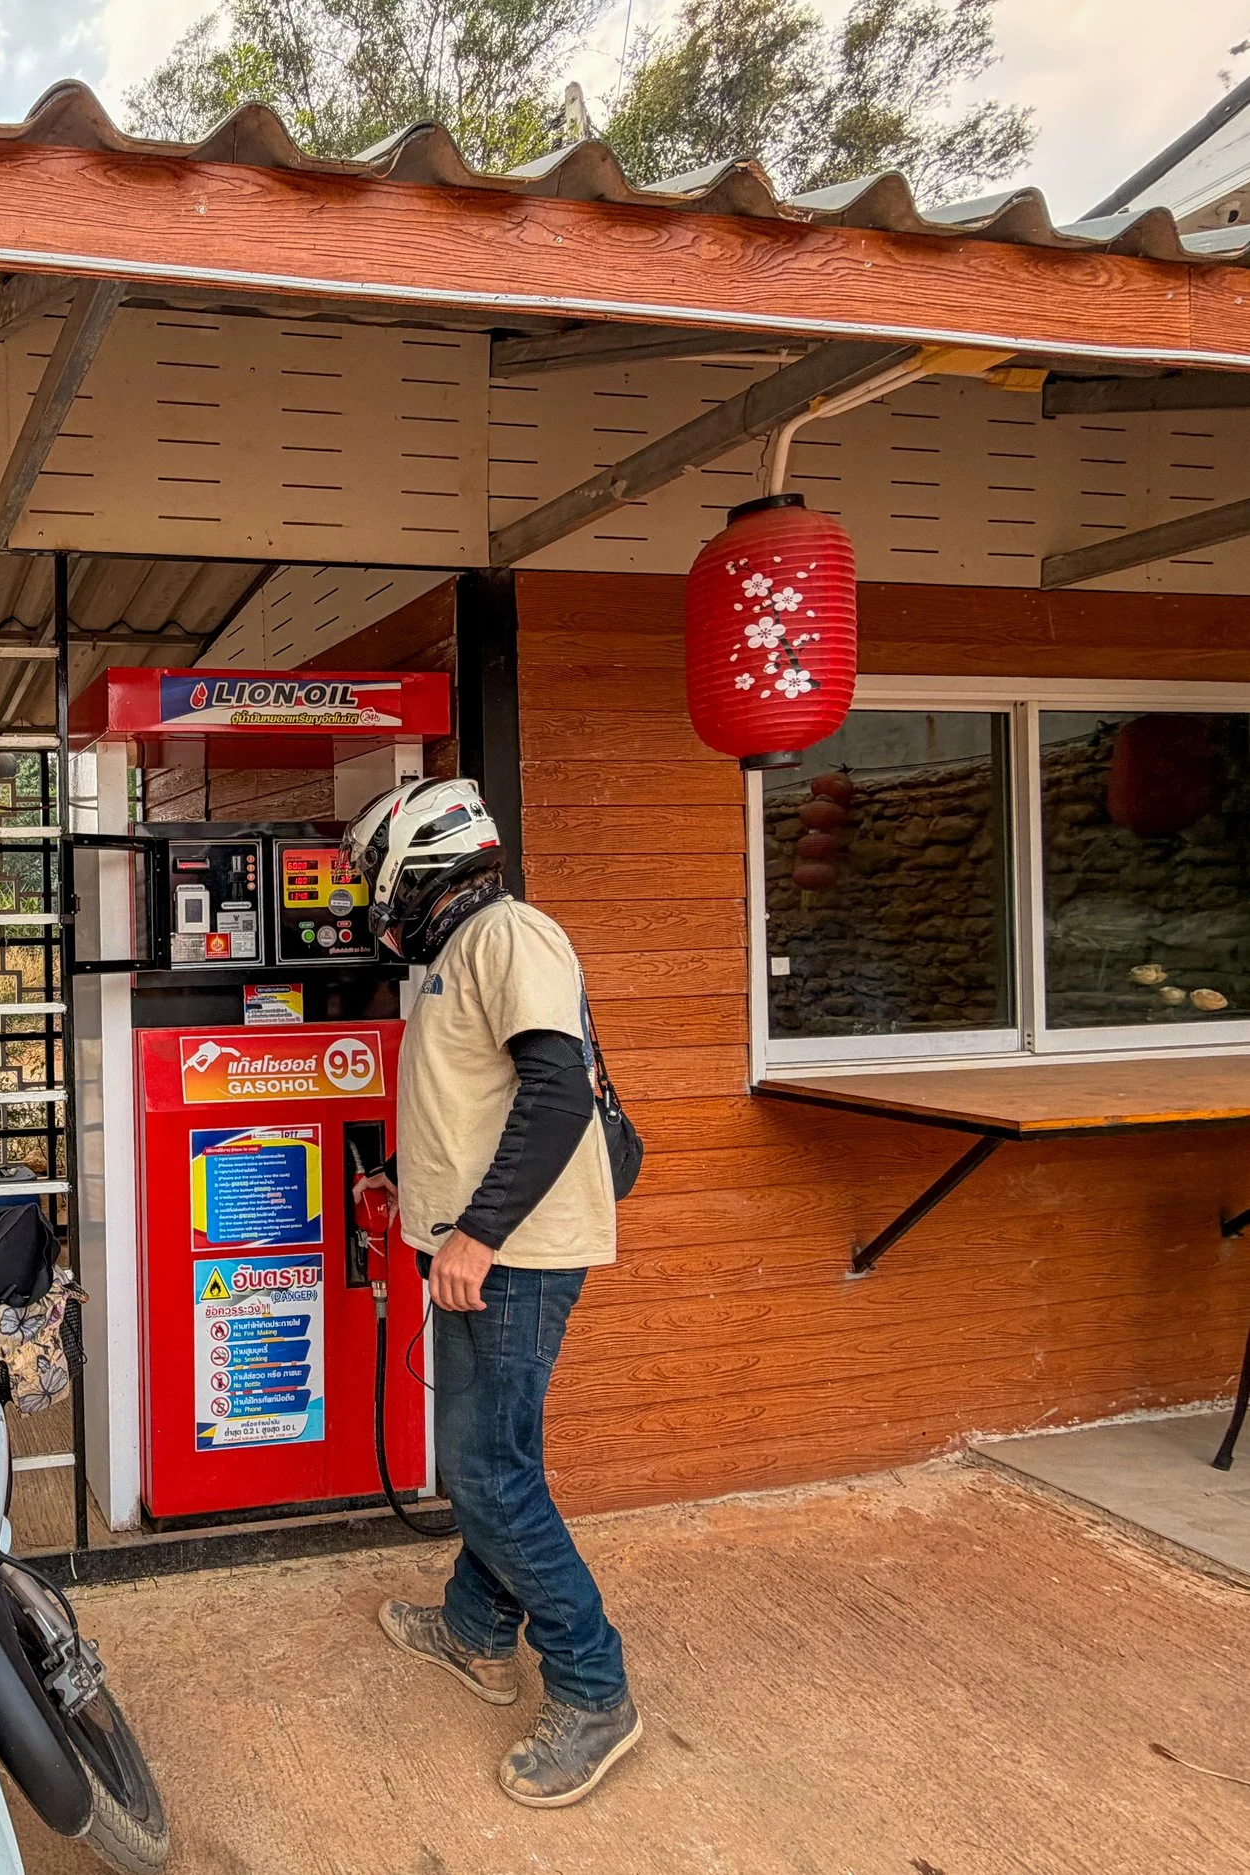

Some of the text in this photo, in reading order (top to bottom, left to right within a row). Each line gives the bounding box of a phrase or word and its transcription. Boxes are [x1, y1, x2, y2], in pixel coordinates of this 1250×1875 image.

[213, 682, 358, 708] LION OIL
[227, 1055, 319, 1074] แก๊สโซฮอล์
[328, 1049, 371, 1080] 95
[228, 1078, 320, 1095] GASOHOL
[232, 1264, 318, 1291] อันตราย
[270, 1290, 318, 1304] (DANGER)
